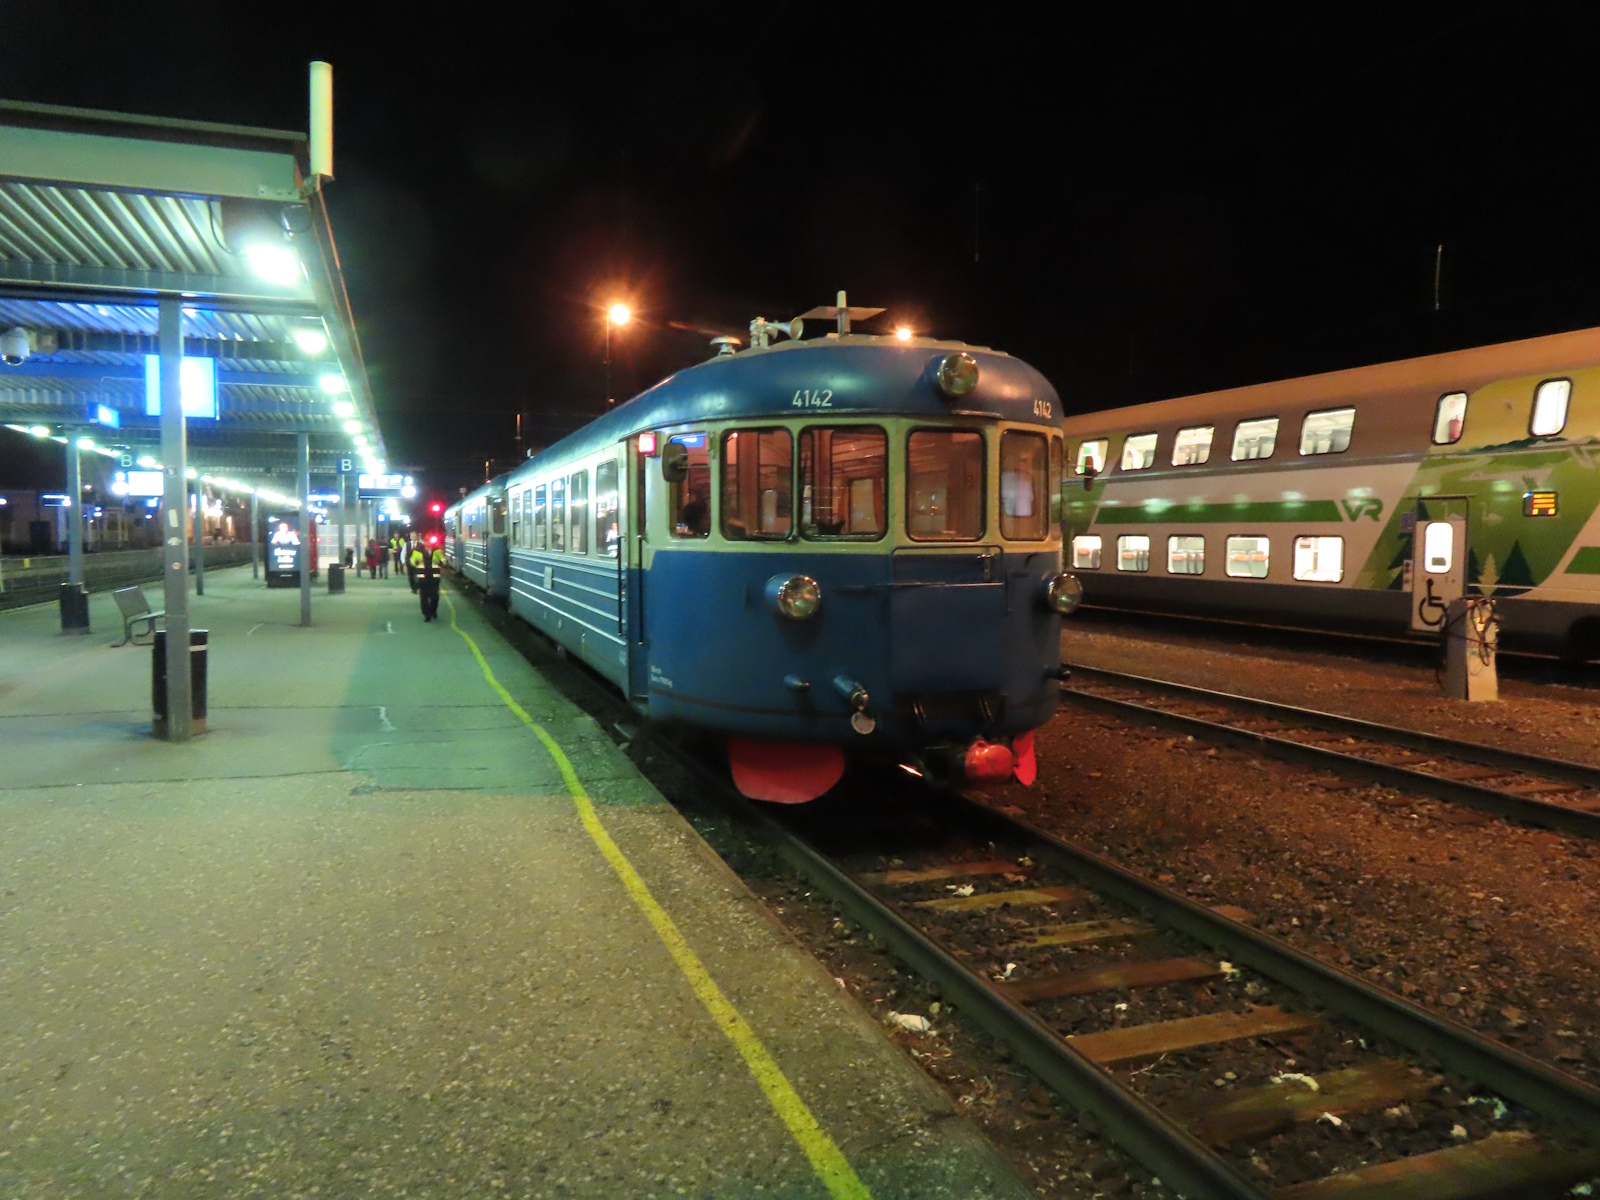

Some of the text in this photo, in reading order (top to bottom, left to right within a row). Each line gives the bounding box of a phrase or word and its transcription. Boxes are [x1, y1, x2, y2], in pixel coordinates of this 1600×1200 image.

[792, 389, 833, 407] 4142
[1033, 399, 1052, 419] 4142
[121, 454, 133, 468] B
[341, 459, 352, 471] B
[1341, 498, 1384, 522] VR
